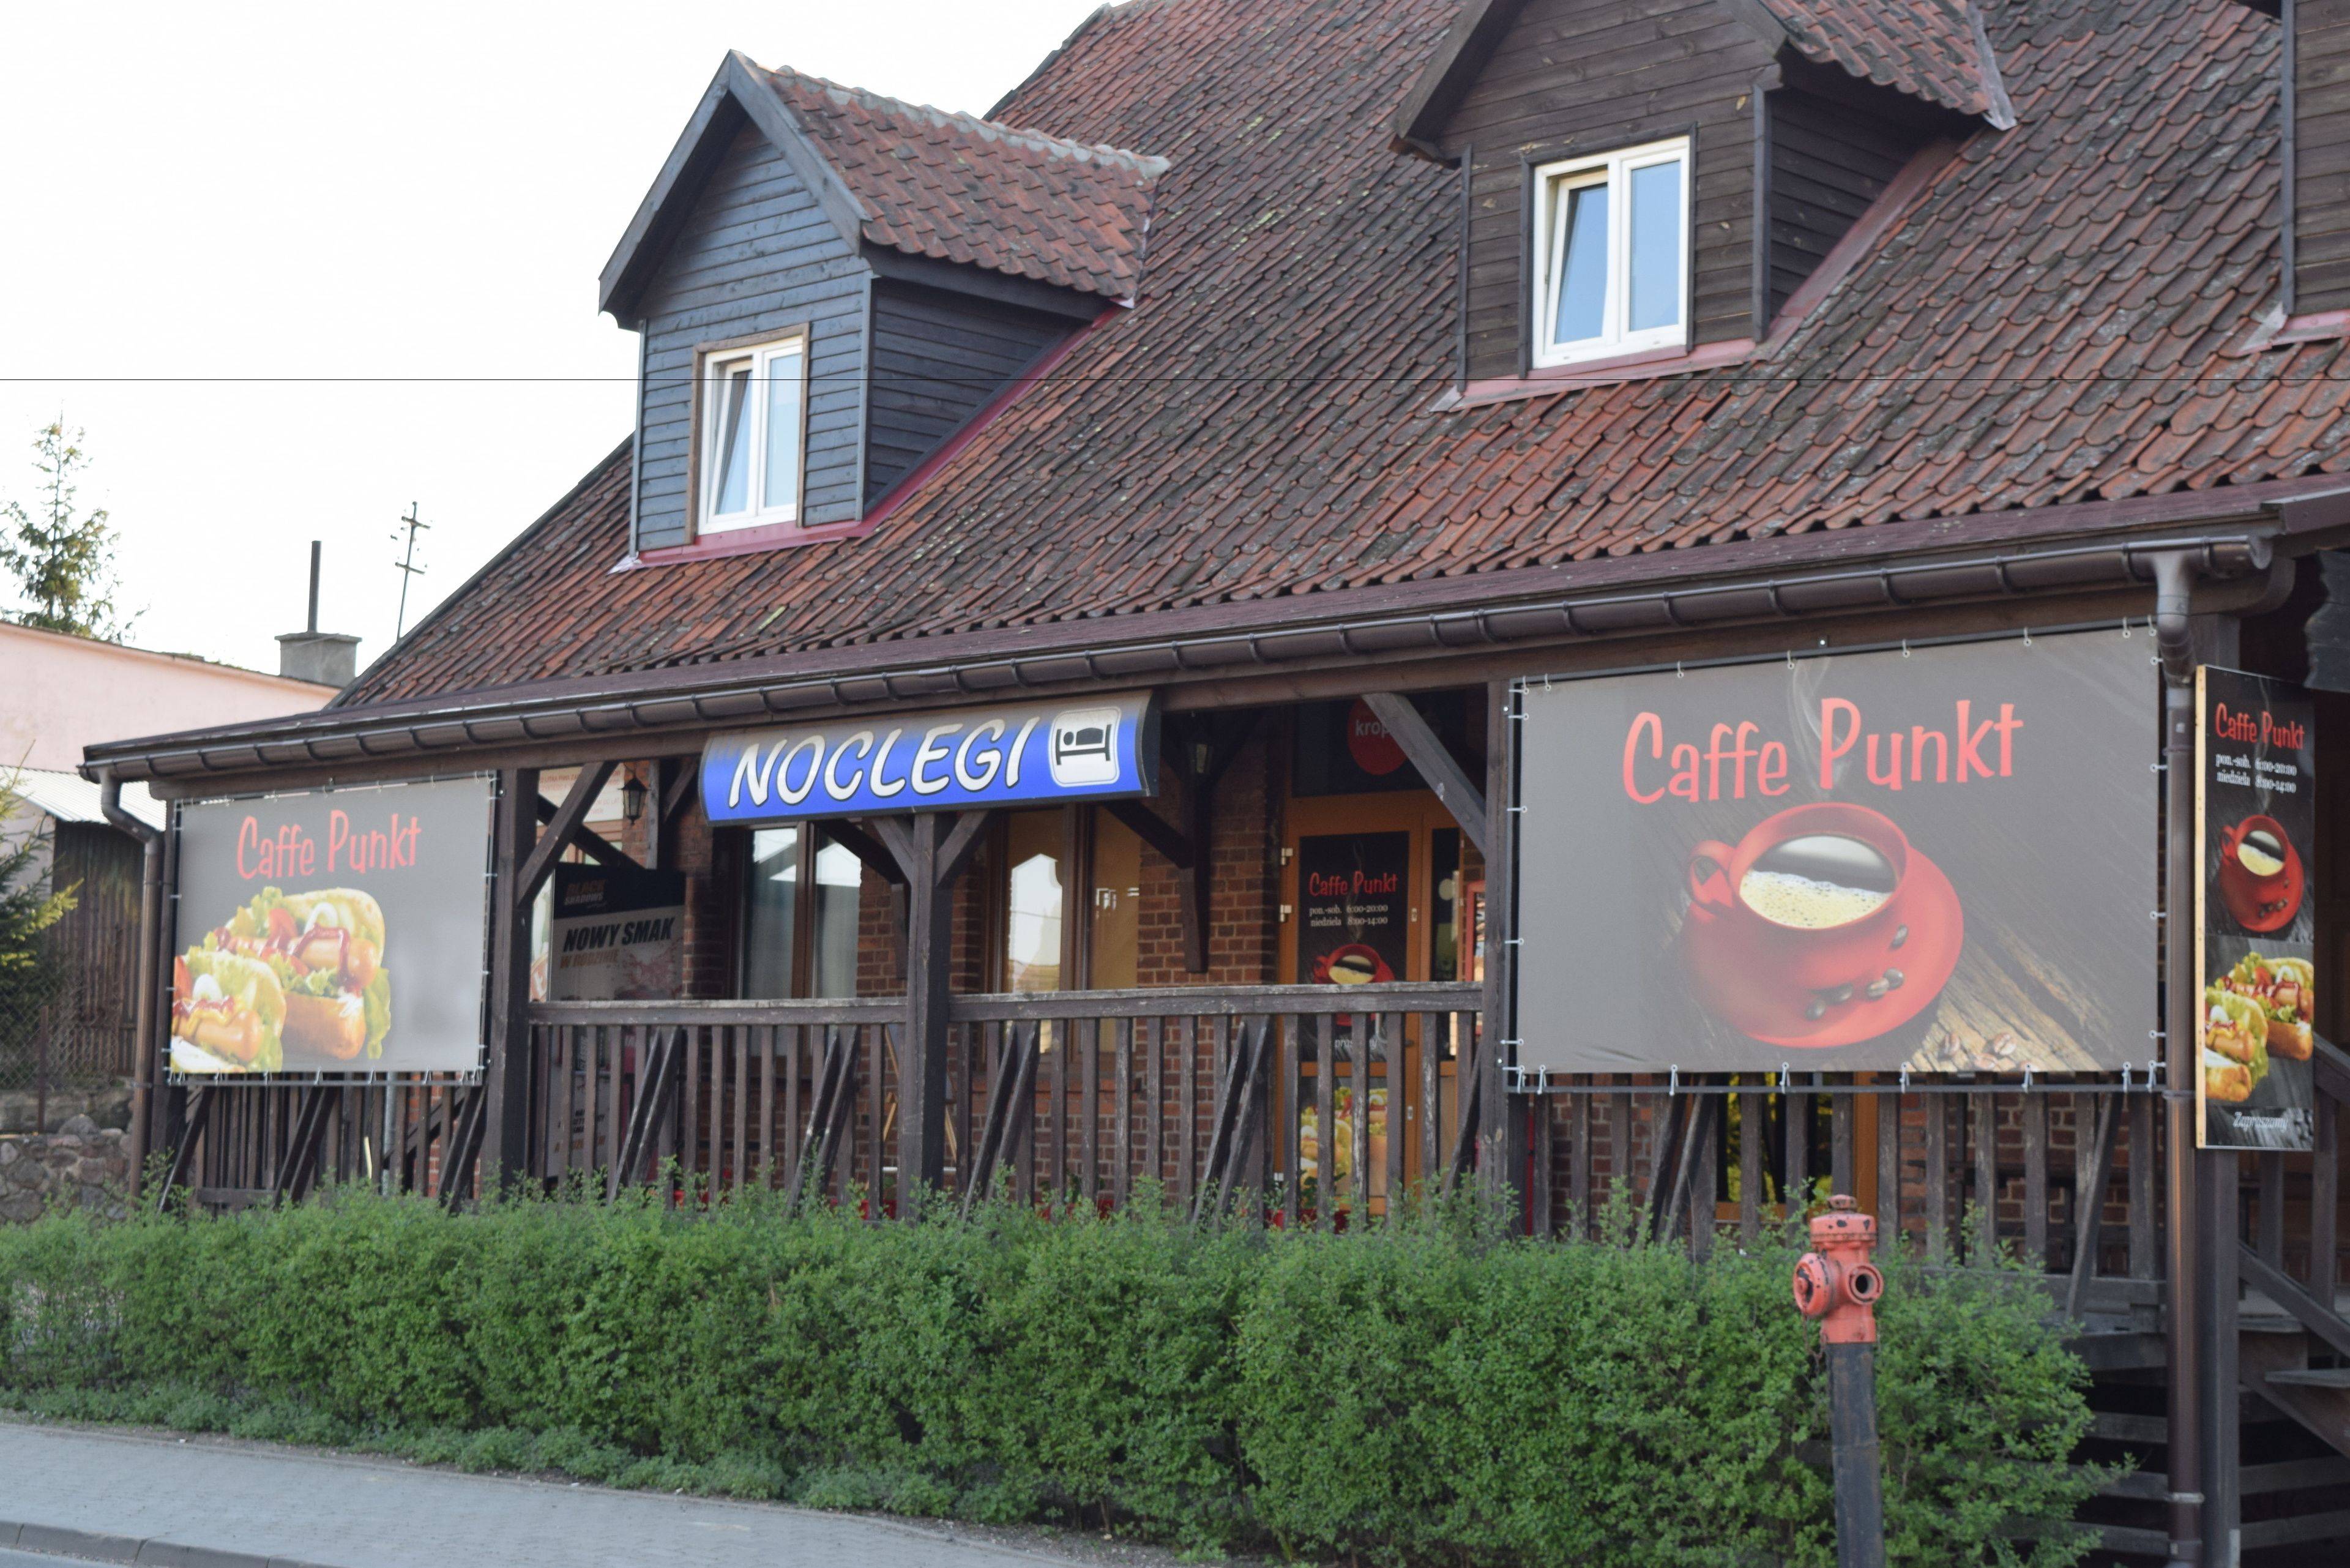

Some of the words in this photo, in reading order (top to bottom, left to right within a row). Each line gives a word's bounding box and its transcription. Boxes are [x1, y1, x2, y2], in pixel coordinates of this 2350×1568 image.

[2215, 702, 2257, 743] Caffe
[2262, 711, 2305, 750] Punkt
[728, 715, 1041, 809] NOCLEGI
[1622, 711, 1791, 804] Caffe
[1819, 698, 2024, 791] Punkt
[237, 815, 315, 879] Caffe
[327, 809, 422, 875] Punkt
[1308, 872, 1348, 897] Caffe
[1352, 870, 1398, 895] Punkt
[1309, 903, 1342, 917] pon.-sob.
[1346, 904, 1389, 914] 6:00-20:00
[1310, 916, 1342, 927] niedziela
[1348, 916, 1388, 927] 8:00-14:00
[562, 922, 622, 953] NOWY
[621, 916, 676, 946] SMAK
[2232, 1111, 2289, 1133] Zapraszamy
